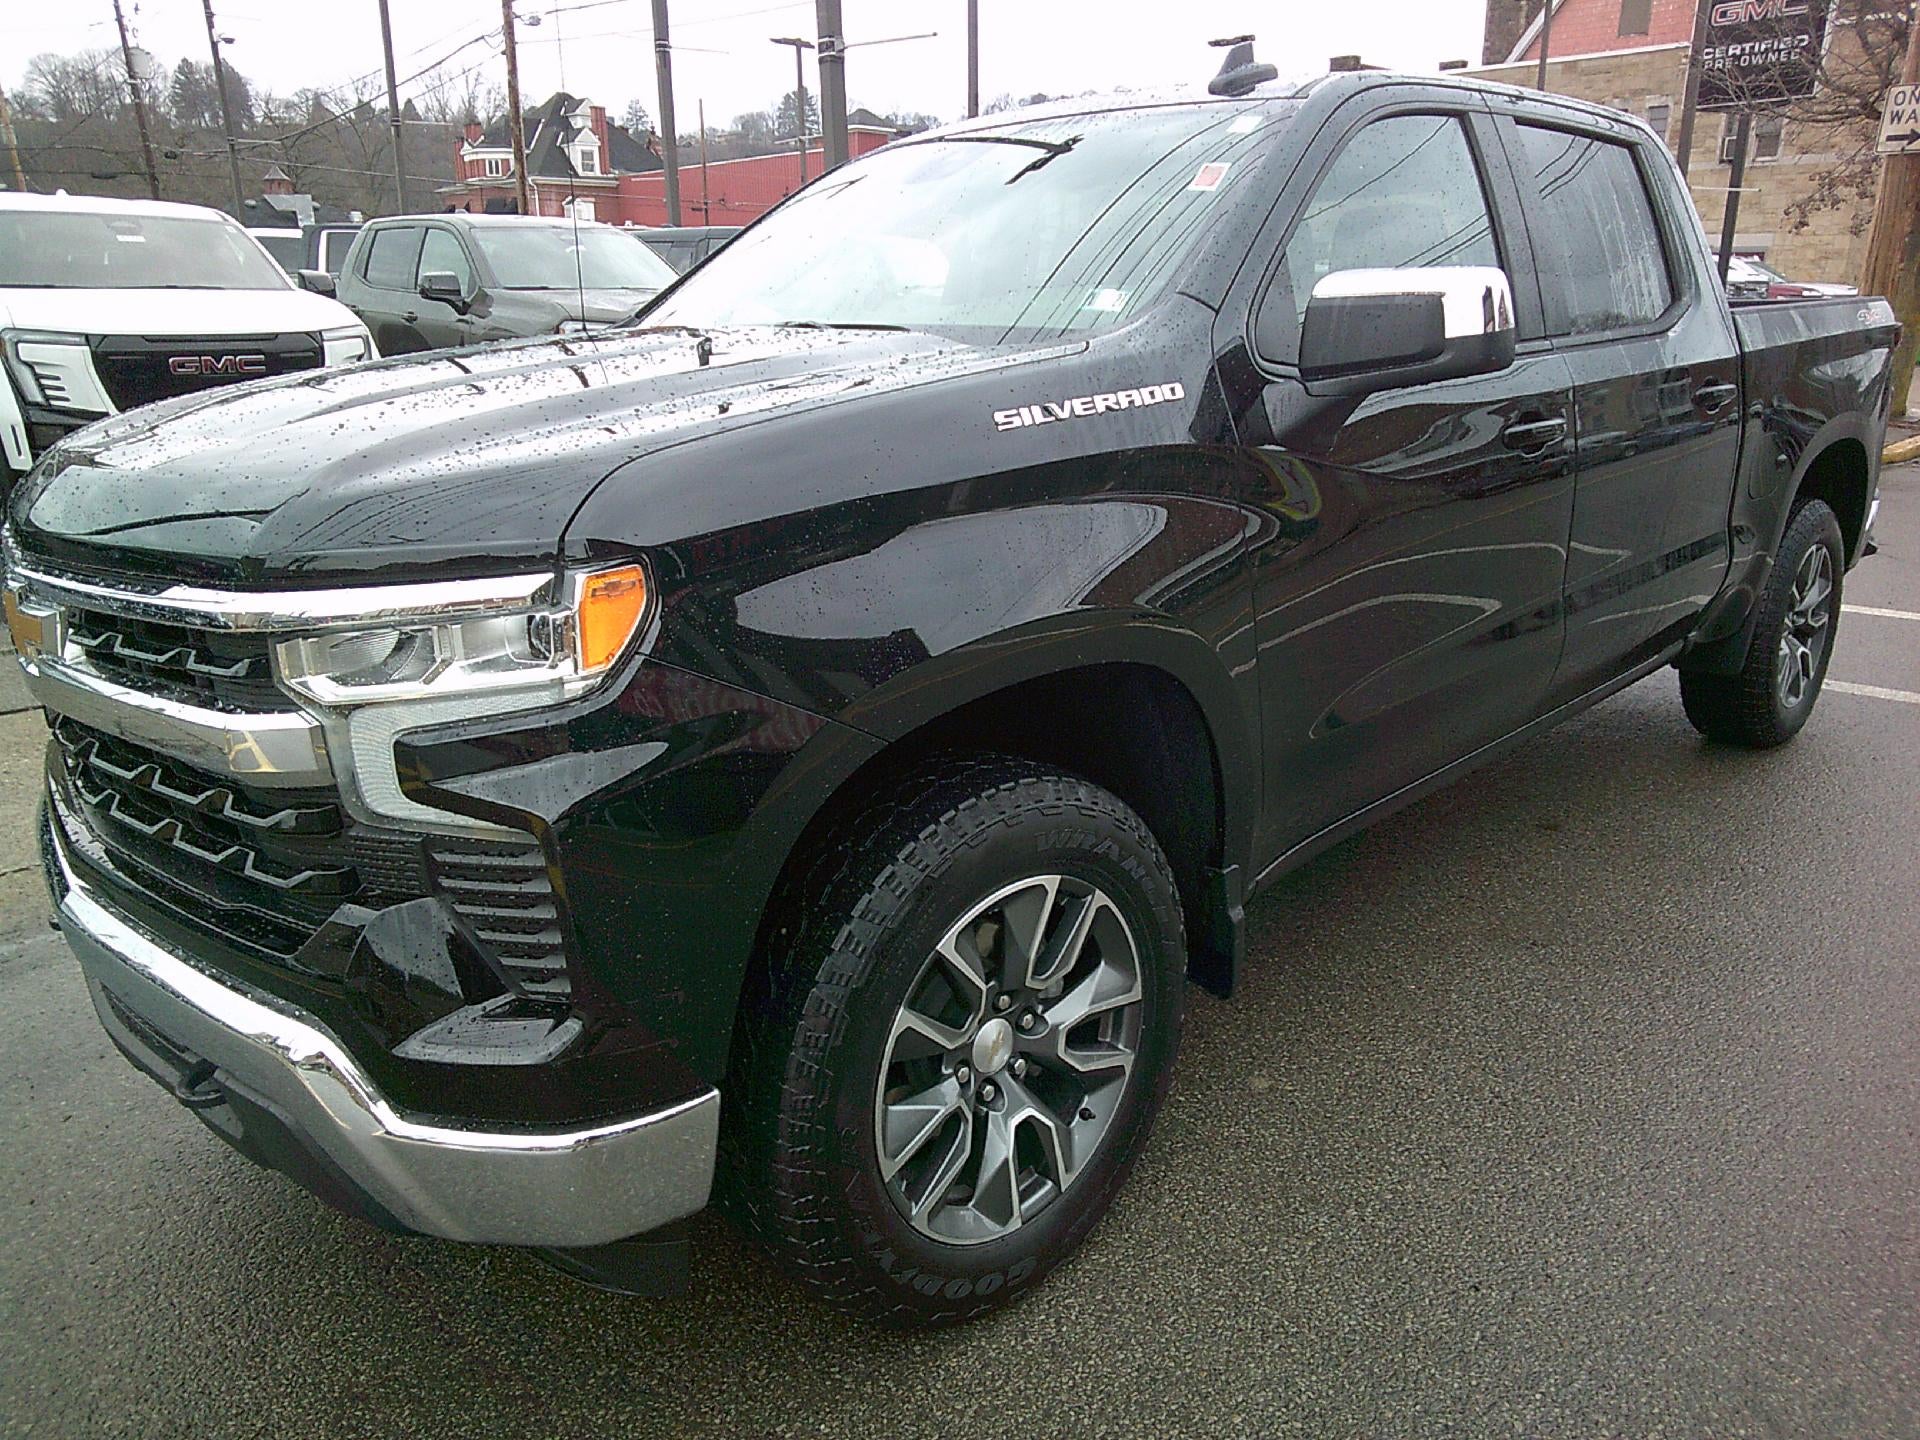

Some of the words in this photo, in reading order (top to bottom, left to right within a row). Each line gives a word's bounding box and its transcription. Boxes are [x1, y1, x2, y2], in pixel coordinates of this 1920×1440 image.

[1703, 34, 1809, 60] CERTIFIED
[1703, 48, 1801, 70] PRE-OWNED
[168, 355, 266, 375] GMC
[993, 382, 1185, 431] SILVERADO
